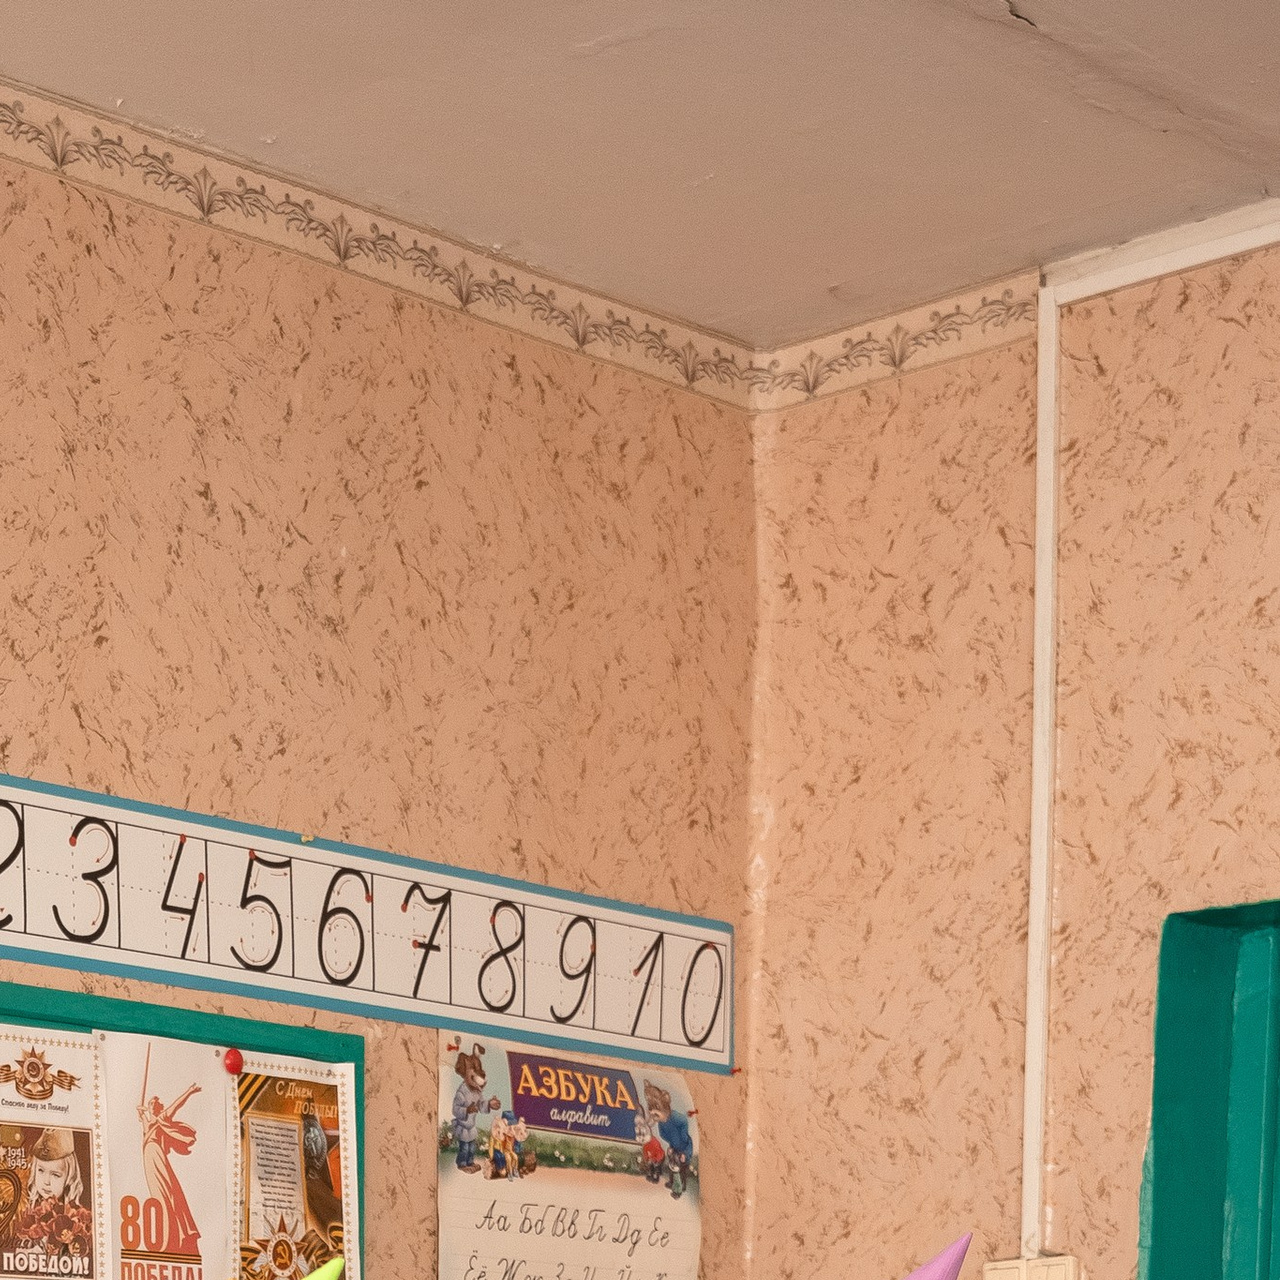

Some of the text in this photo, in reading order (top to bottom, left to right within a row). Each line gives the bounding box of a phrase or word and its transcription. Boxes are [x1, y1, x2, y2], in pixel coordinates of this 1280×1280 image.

[52, 816, 118, 944] 3
[161, 834, 205, 960] 4
[229, 850, 292, 973] 5
[318, 867, 373, 987] 6
[401, 882, 452, 999] 7
[477, 900, 524, 1014] 8
[549, 915, 596, 1024] 9
[632, 932, 724, 1047] 10
[517, 1064, 636, 1110] АЗБУКА
[550, 1105, 611, 1130] алфавит
[7, 1146, 26, 1158] 1941
[7, 1158, 28, 1170] 1945
[120, 1195, 164, 1252] 80
[475, 1200, 511, 1232] Аа
[519, 1203, 555, 1235] Бб
[551, 1207, 580, 1239] Вв
[583, 1209, 607, 1242] Гг
[648, 1216, 670, 1248] Ее
[3, 1252, 90, 1276] ПОБЕДОЙ!
